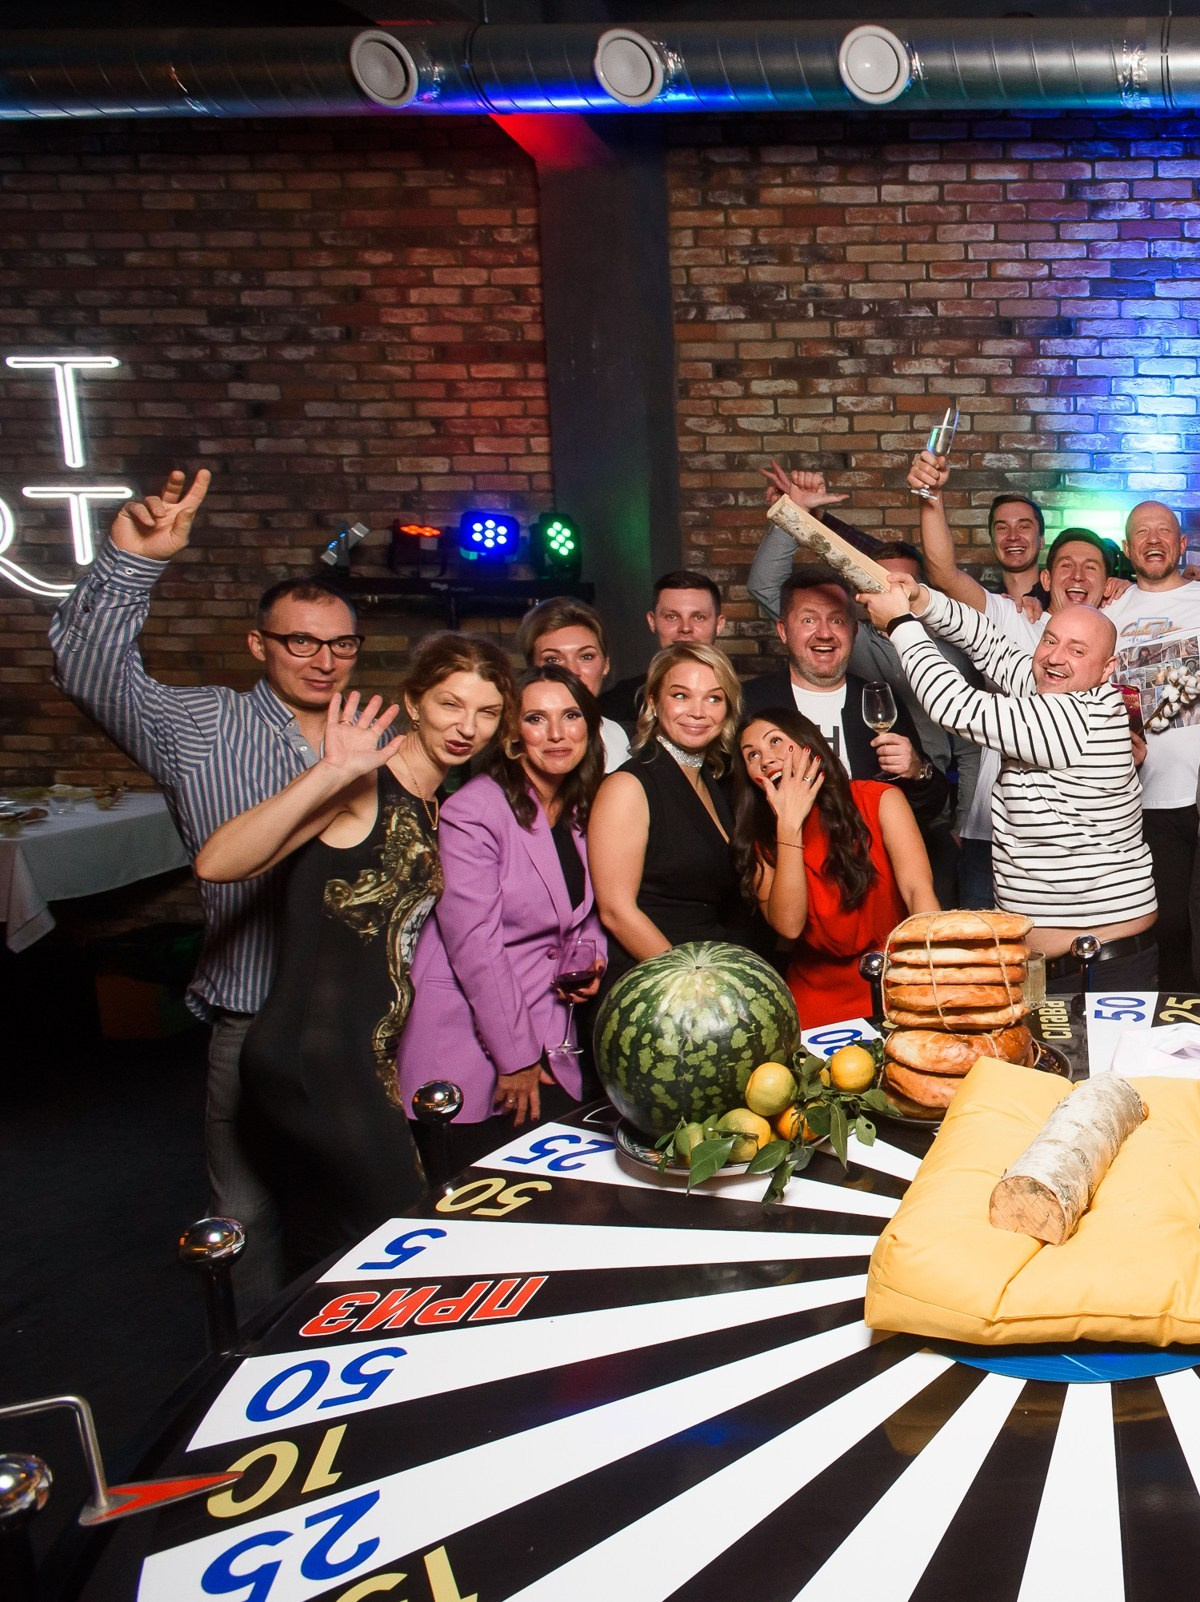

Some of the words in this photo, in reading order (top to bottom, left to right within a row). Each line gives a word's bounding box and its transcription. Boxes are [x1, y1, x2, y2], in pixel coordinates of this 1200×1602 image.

[1094, 996, 1146, 1022] 50
[502, 1133, 616, 1172] 25
[434, 1177, 554, 1217] 50
[356, 1227, 449, 1271] 5
[299, 1275, 550, 1337] ПРИЗ
[244, 1346, 409, 1423] 50
[206, 1423, 349, 1519] 10
[200, 1488, 382, 1602] 25
